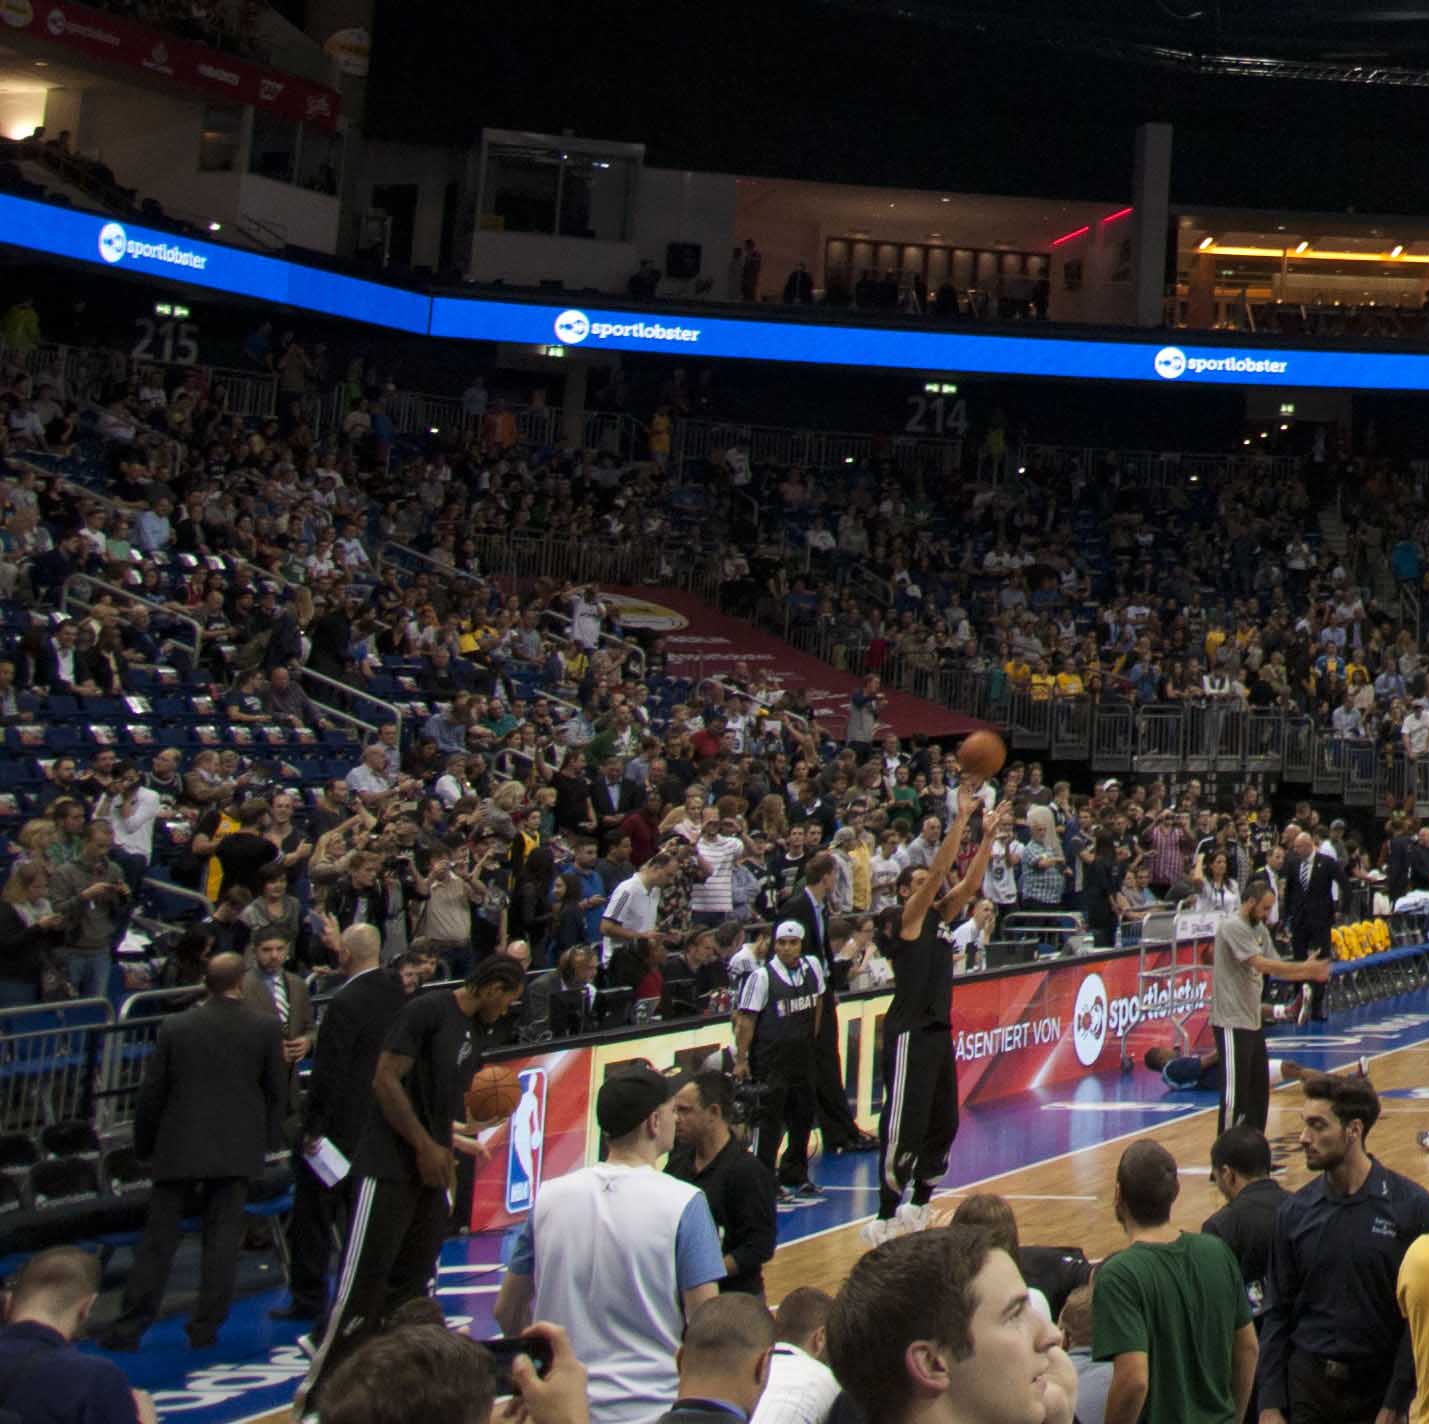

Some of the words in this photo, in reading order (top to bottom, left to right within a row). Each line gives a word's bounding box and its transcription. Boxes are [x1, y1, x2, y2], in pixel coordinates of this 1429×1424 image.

[127, 238, 205, 269] sportlobster
[132, 319, 200, 366] 215
[592, 320, 699, 342] sportlobster
[1188, 356, 1285, 373] sportlobster
[905, 395, 969, 433] 214
[954, 1021, 1030, 1062] ÄSENTIERT
[1033, 1016, 1062, 1044] VON
